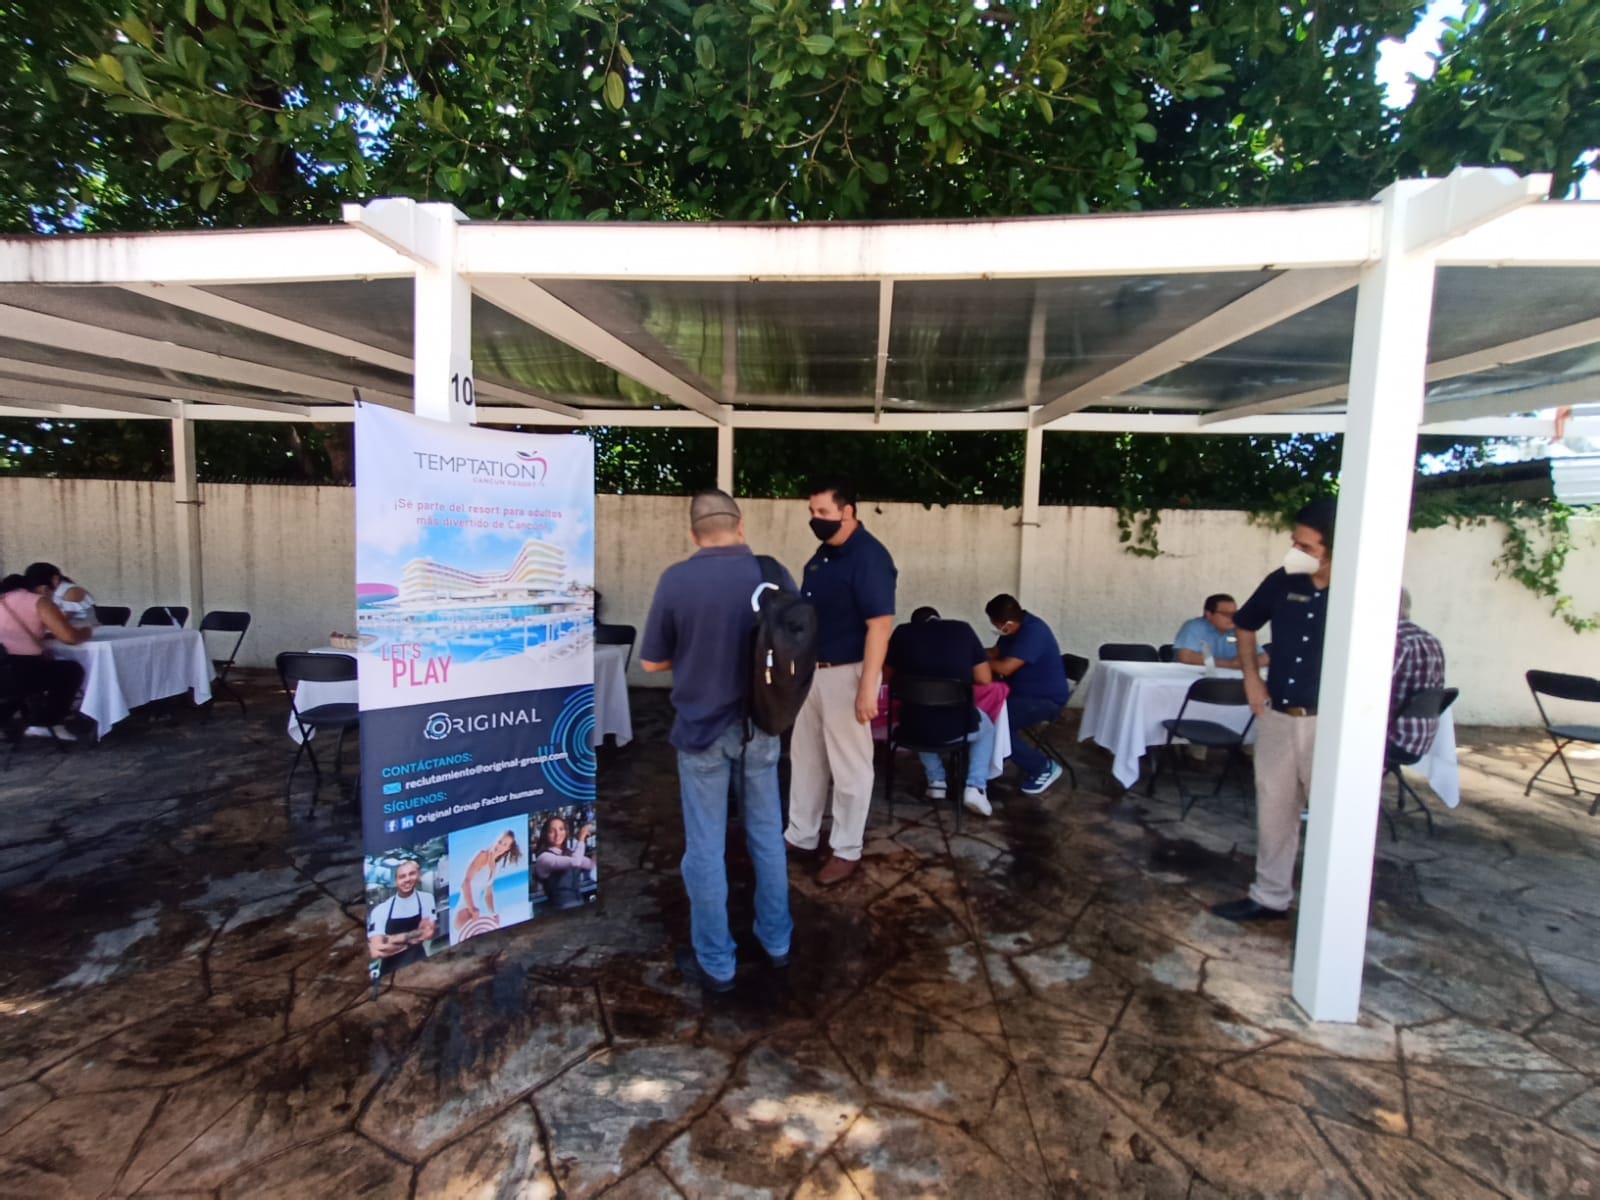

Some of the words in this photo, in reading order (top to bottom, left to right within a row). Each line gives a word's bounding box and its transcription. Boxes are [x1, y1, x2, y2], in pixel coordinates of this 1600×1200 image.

[451, 372, 473, 406] 10
[414, 452, 536, 480] TEMPTATION
[416, 515, 439, 525] más
[443, 516, 489, 529] divertido
[492, 519, 505, 529] de
[417, 501, 445, 513] parte
[450, 502, 465, 513] del
[469, 504, 500, 515] resort
[503, 507, 525, 518] para
[528, 507, 562, 519] adultos
[382, 643, 421, 661] LET'S
[392, 656, 452, 688] PLAY
[424, 708, 542, 740] ORIGINAL
[382, 752, 473, 778] CONTÁCTANOS:
[405, 752, 568, 790] reclutamiento@original-group.com
[384, 791, 448, 814] SÍGUENOS:
[416, 807, 452, 824] Original
[453, 801, 481, 814] Group
[481, 795, 508, 807] Factor
[509, 788, 544, 800] humano
